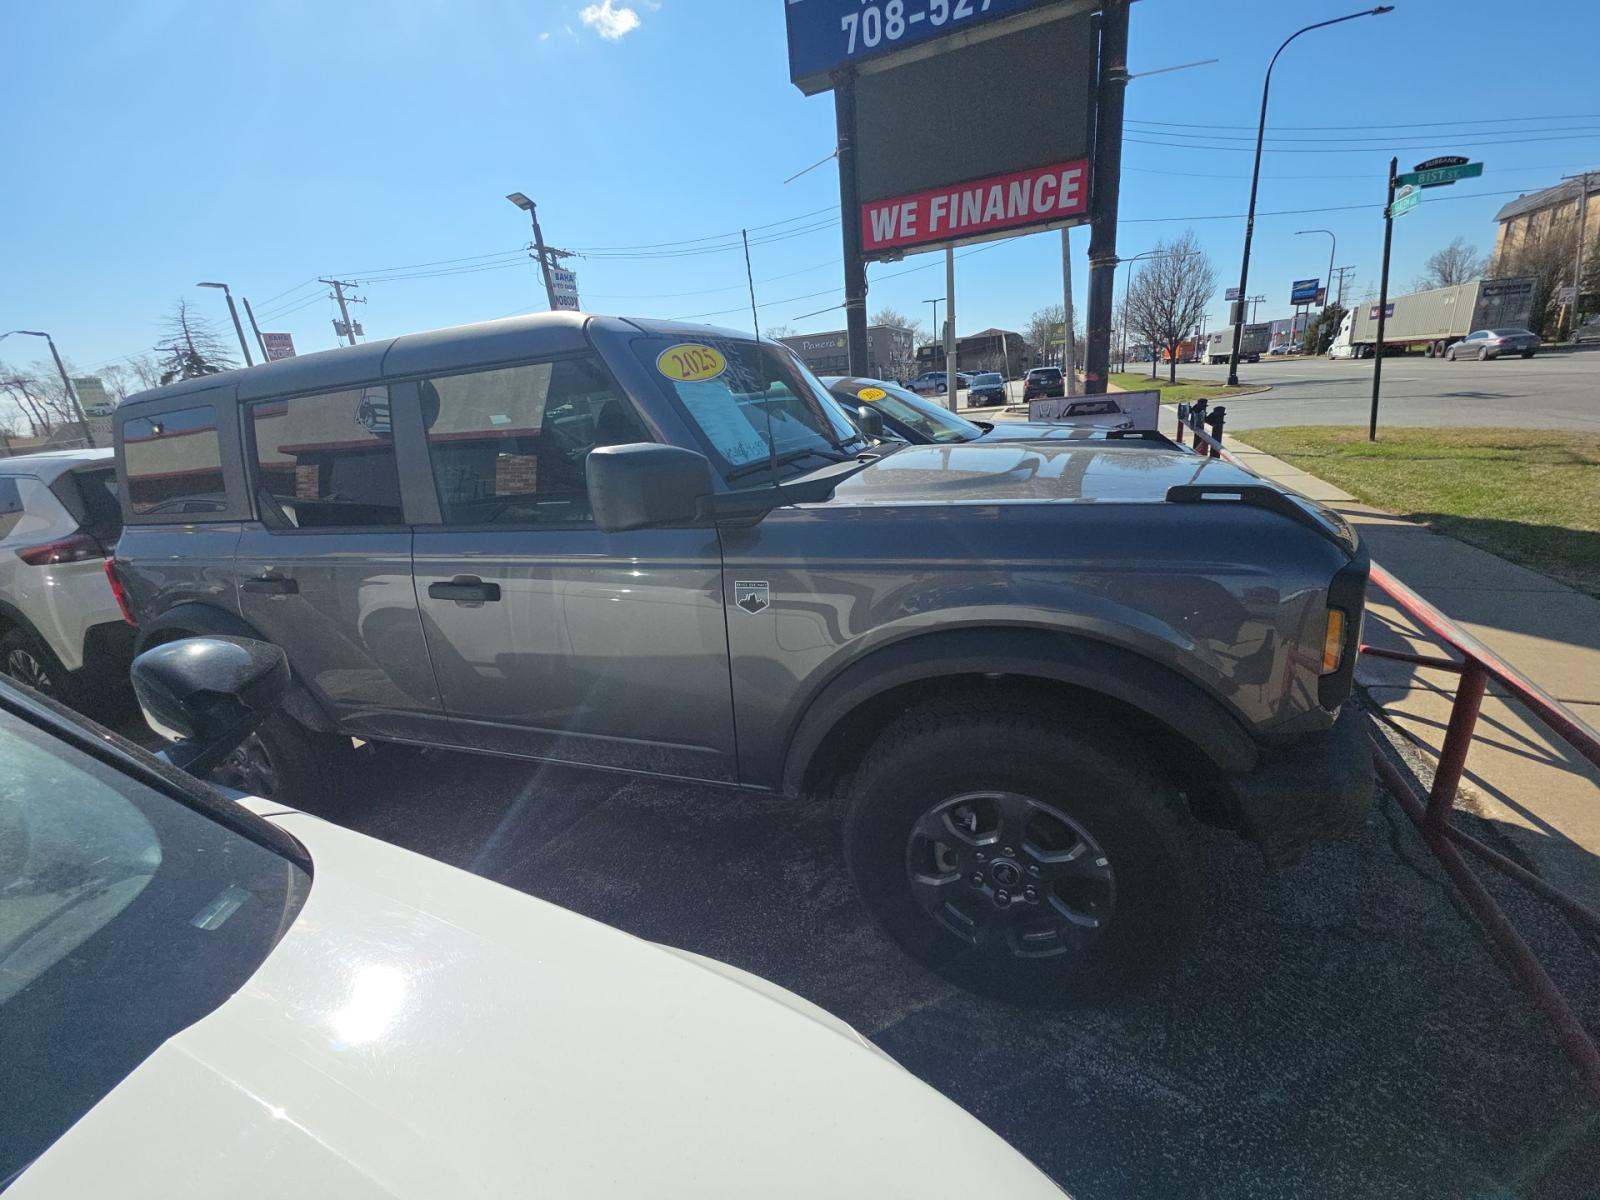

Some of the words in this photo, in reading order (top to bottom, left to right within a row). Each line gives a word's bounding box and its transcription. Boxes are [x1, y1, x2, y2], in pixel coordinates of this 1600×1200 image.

[1418, 171, 1445, 183] 81ST
[869, 201, 918, 243] WE
[929, 168, 1082, 233] FINANCE
[802, 339, 836, 351] Panera
[671, 348, 717, 378] 2025
